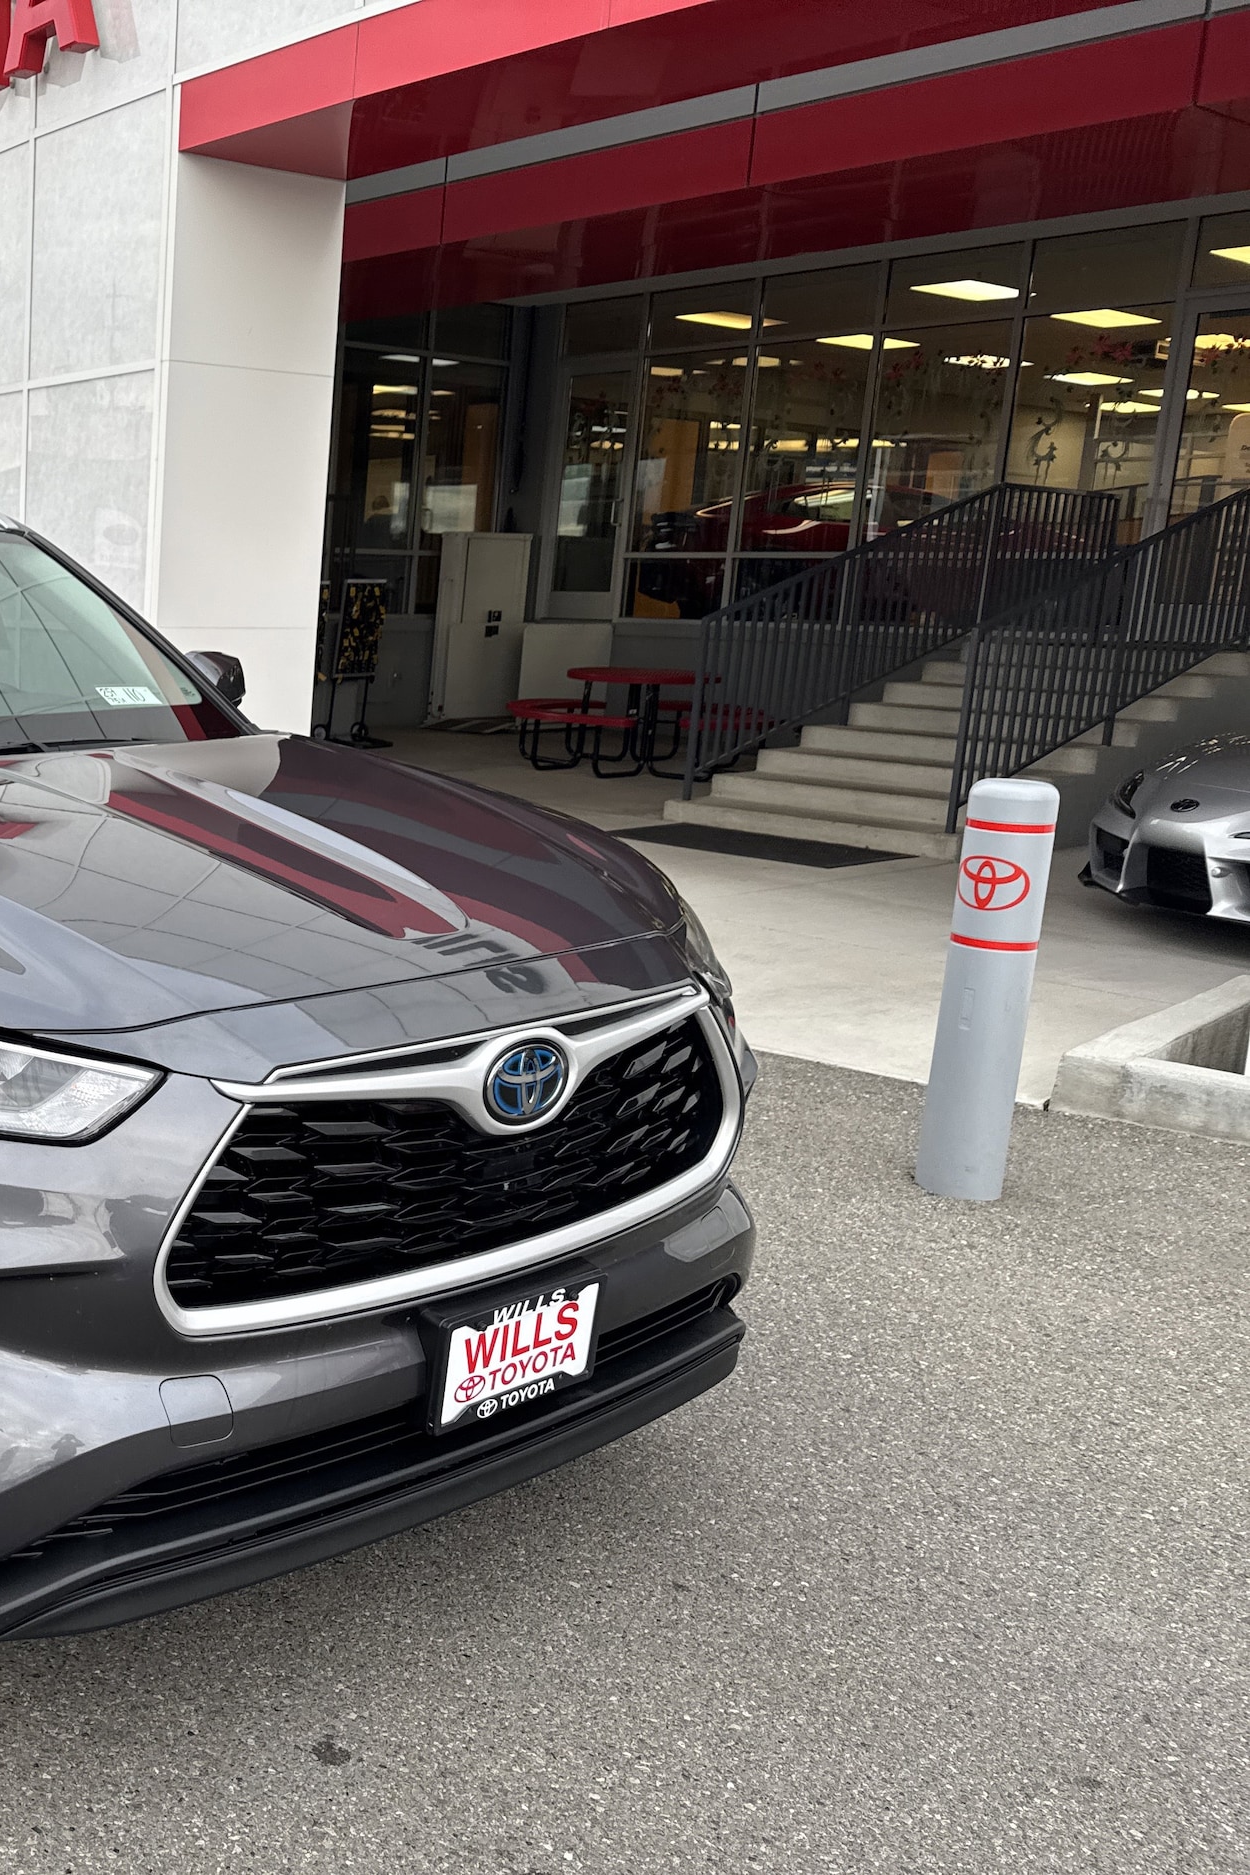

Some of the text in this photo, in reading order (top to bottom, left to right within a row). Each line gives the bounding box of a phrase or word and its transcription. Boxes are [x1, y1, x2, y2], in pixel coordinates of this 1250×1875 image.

[493, 1287, 566, 1325] WILLS
[464, 1302, 579, 1374] WILLS
[488, 1342, 576, 1391] TOYOTA
[500, 1378, 555, 1409] TOYOTA
